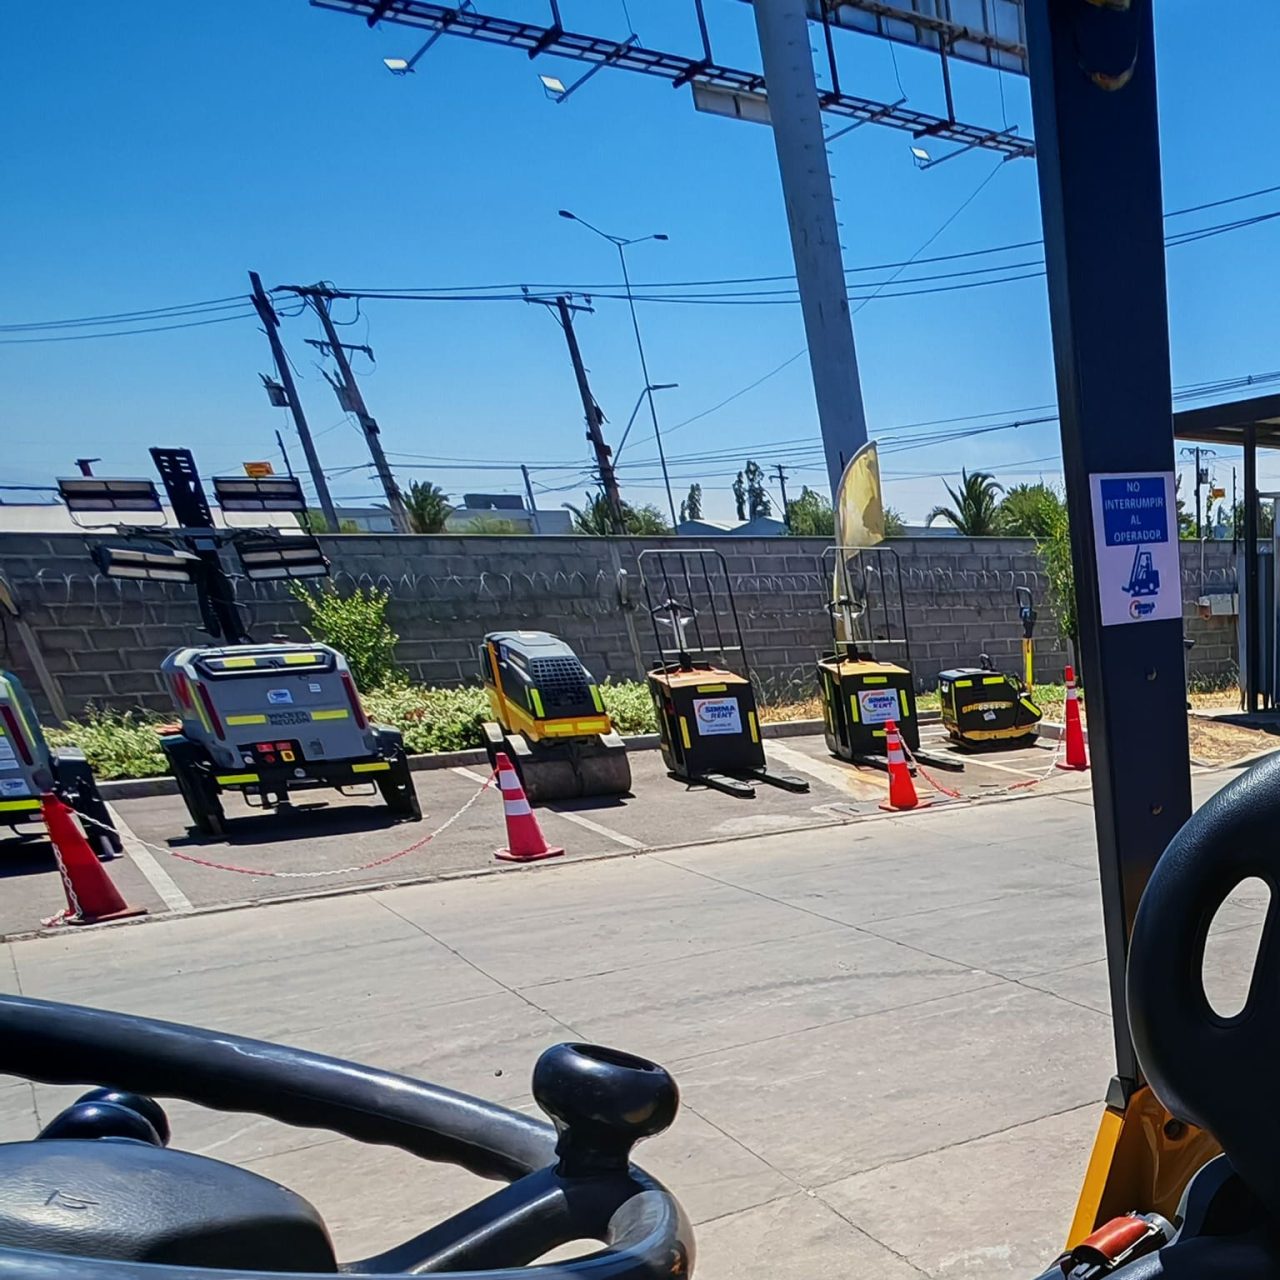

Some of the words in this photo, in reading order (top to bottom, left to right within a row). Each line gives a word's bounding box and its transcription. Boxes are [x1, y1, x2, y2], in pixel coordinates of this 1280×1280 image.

[1126, 481, 1140, 492] NO
[1105, 497, 1163, 510] INTERRUMPIR
[1130, 515, 1142, 525] AL
